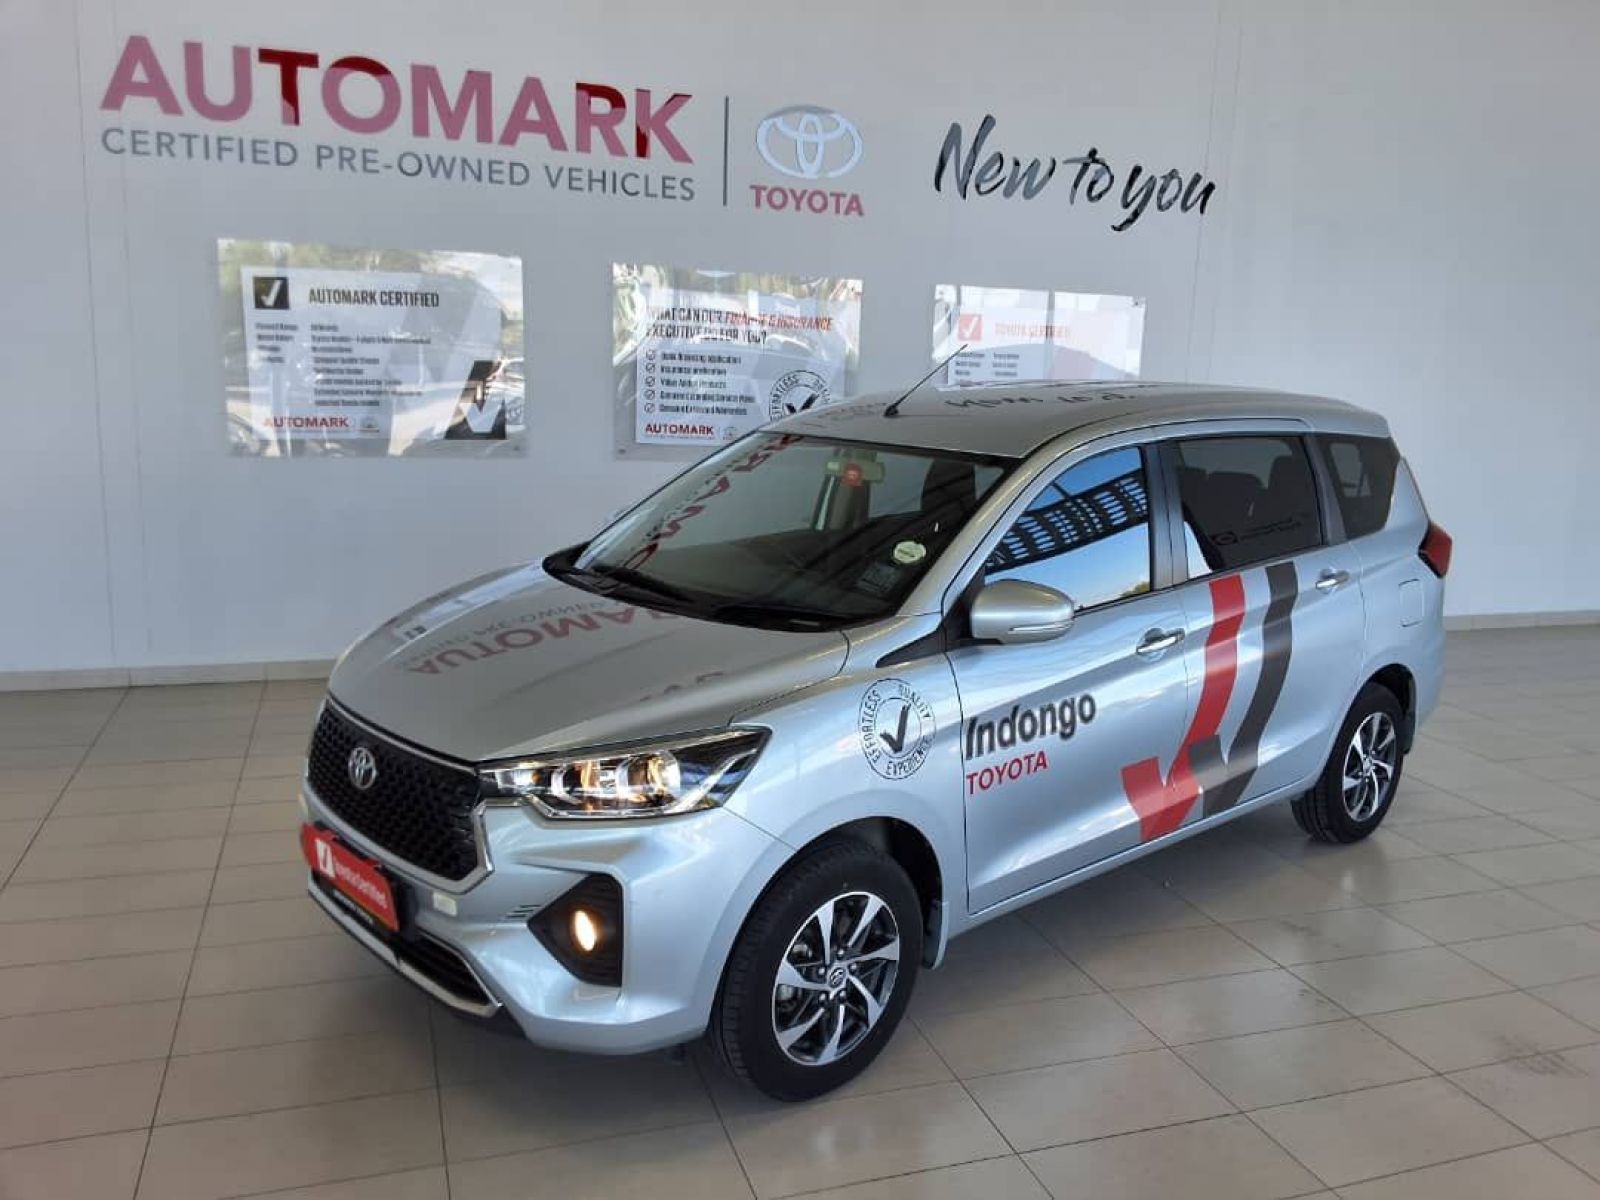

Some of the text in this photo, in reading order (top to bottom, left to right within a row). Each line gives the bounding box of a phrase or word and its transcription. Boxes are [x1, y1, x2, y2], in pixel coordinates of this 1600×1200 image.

[100, 35, 694, 164] AUTOMARK
[101, 127, 695, 201] CERTIFIED PRE-OWNED VEHICLES
[934, 114, 1217, 232] New to you
[749, 185, 865, 217] TOYOTA
[309, 288, 439, 308] AUTOMARK CERTIFIED
[679, 307, 700, 323] CAN
[264, 415, 349, 429] AUTOMARK
[645, 423, 714, 436] AUTOMARK
[965, 693, 1097, 761] Indongo
[966, 750, 1048, 795] TOYOTA
